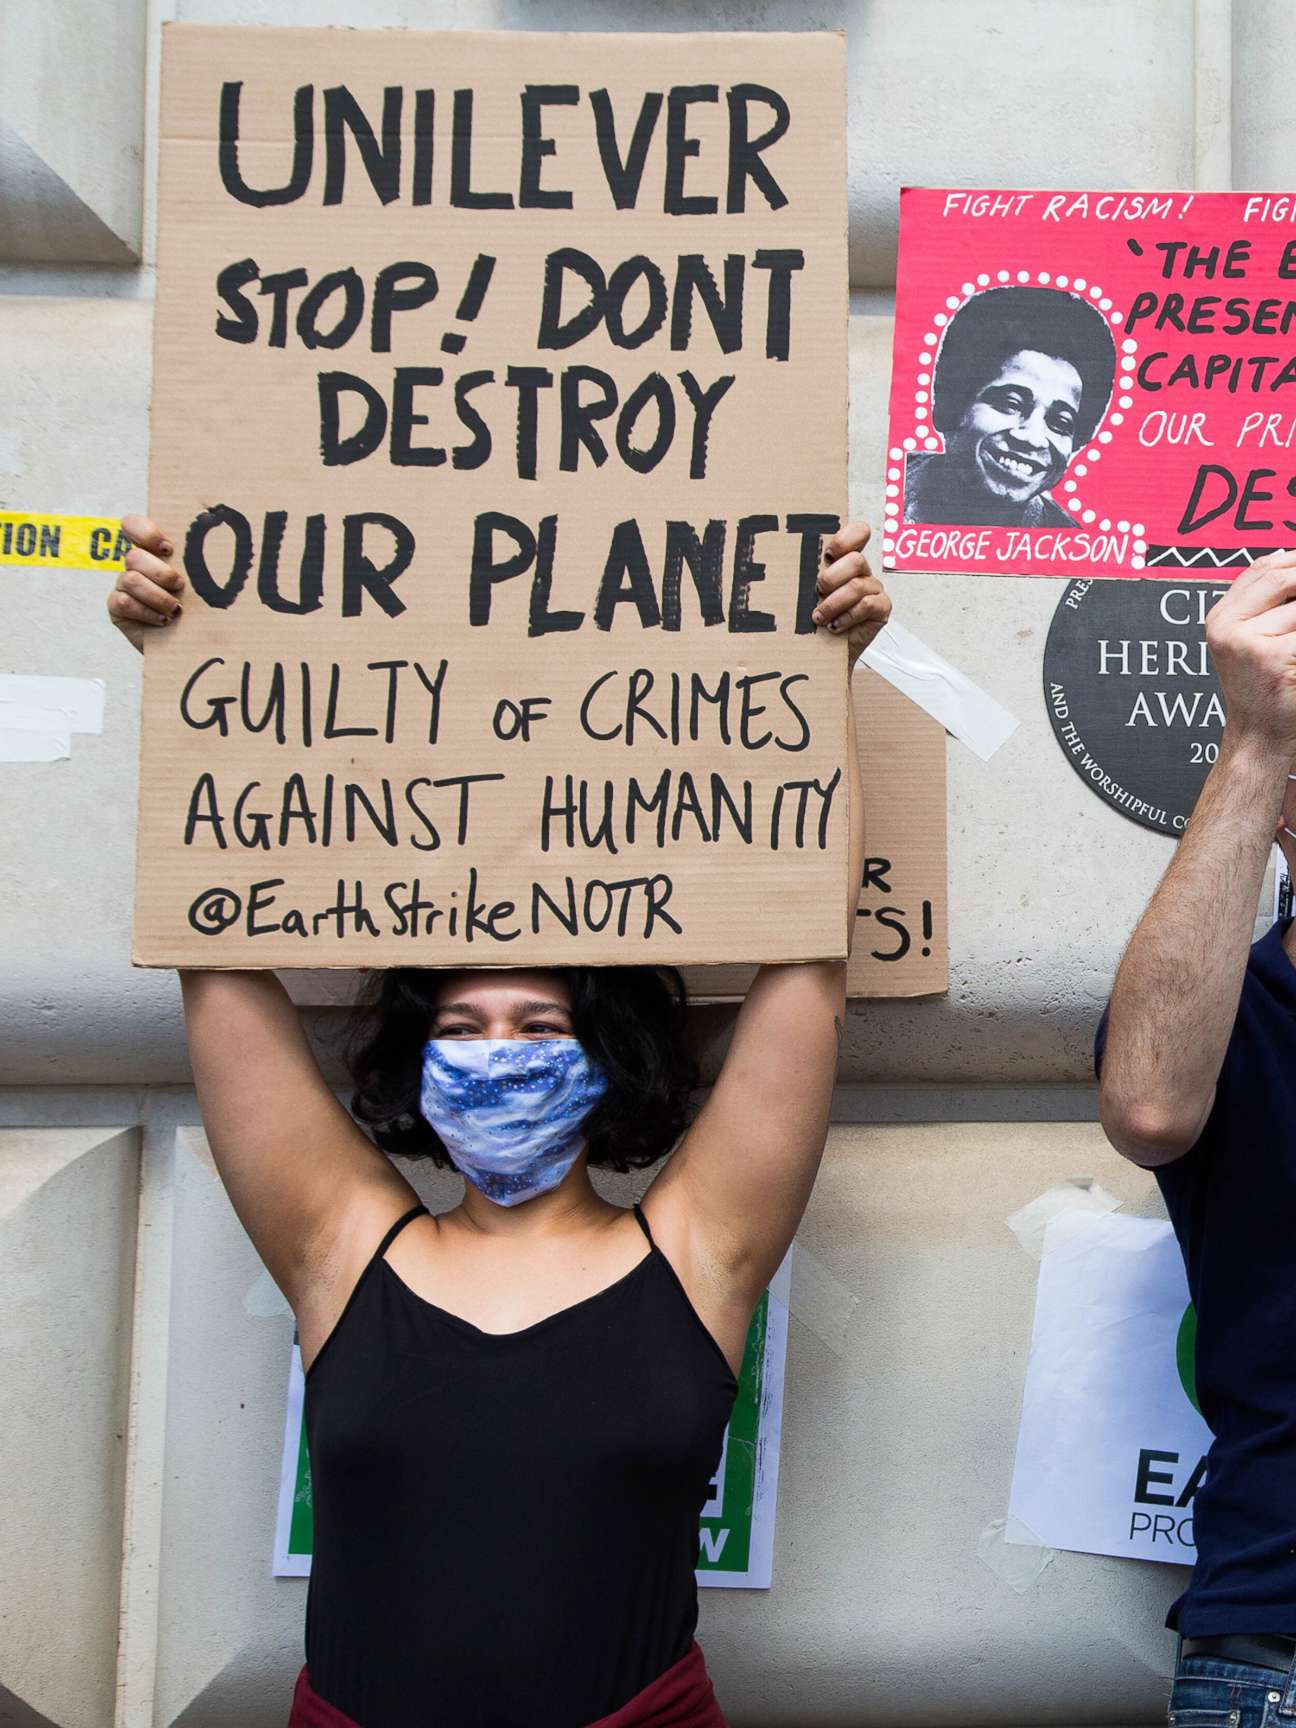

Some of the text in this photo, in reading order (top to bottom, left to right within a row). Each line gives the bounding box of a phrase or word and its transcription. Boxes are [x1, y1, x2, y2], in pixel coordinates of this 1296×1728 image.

[219, 81, 791, 216] UNILEVER
[942, 192, 1035, 218] FIGHT
[1042, 193, 1194, 223] RACISM!
[215, 247, 805, 362] STOP! DONT
[317, 365, 736, 481] DESTROY
[1138, 410, 1215, 448] OUR
[0, 522, 61, 558] ION
[183, 503, 840, 638] OUR PLANET
[895, 528, 1130, 566] GEORGE JACKSON
[180, 657, 449, 748] GUILTY
[492, 697, 552, 743] OF
[580, 668, 811, 752] CRIMES
[1050, 682, 1069, 720] AND
[1061, 721, 1085, 756] THE
[1080, 753, 1168, 826] WORSHIPFUL
[184, 772, 506, 852] AGAINST
[541, 766, 842, 855] HUMANITY
